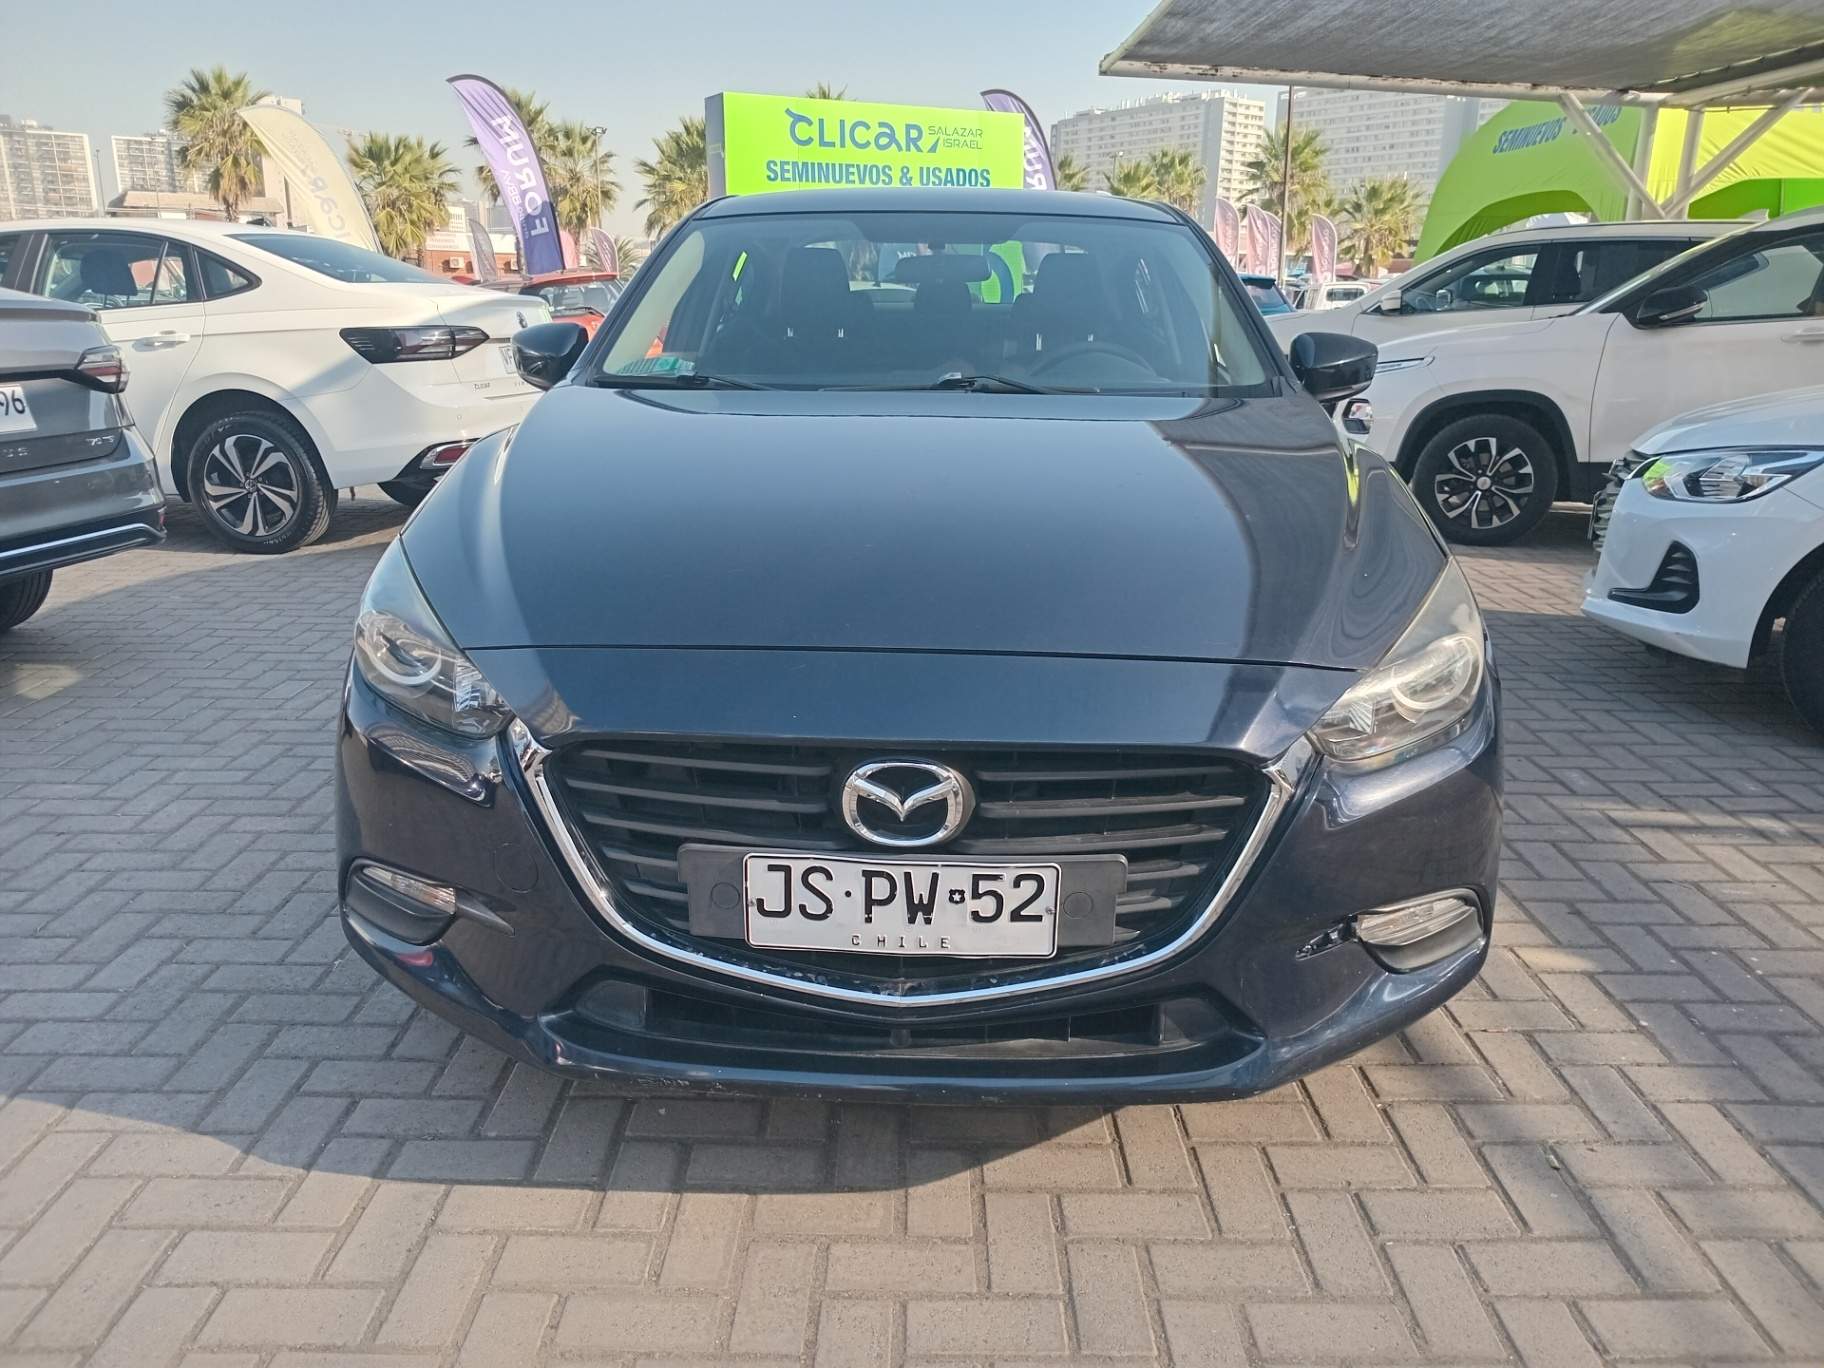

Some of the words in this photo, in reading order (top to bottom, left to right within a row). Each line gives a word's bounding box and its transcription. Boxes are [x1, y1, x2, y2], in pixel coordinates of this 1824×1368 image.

[927, 125, 983, 139] SALAZAR
[942, 138, 983, 149] ISRAEL
[766, 160, 893, 186] SEMINUEVOS
[899, 165, 913, 186] &
[919, 167, 991, 187] USADOS
[851, 935, 951, 949] CHILE
